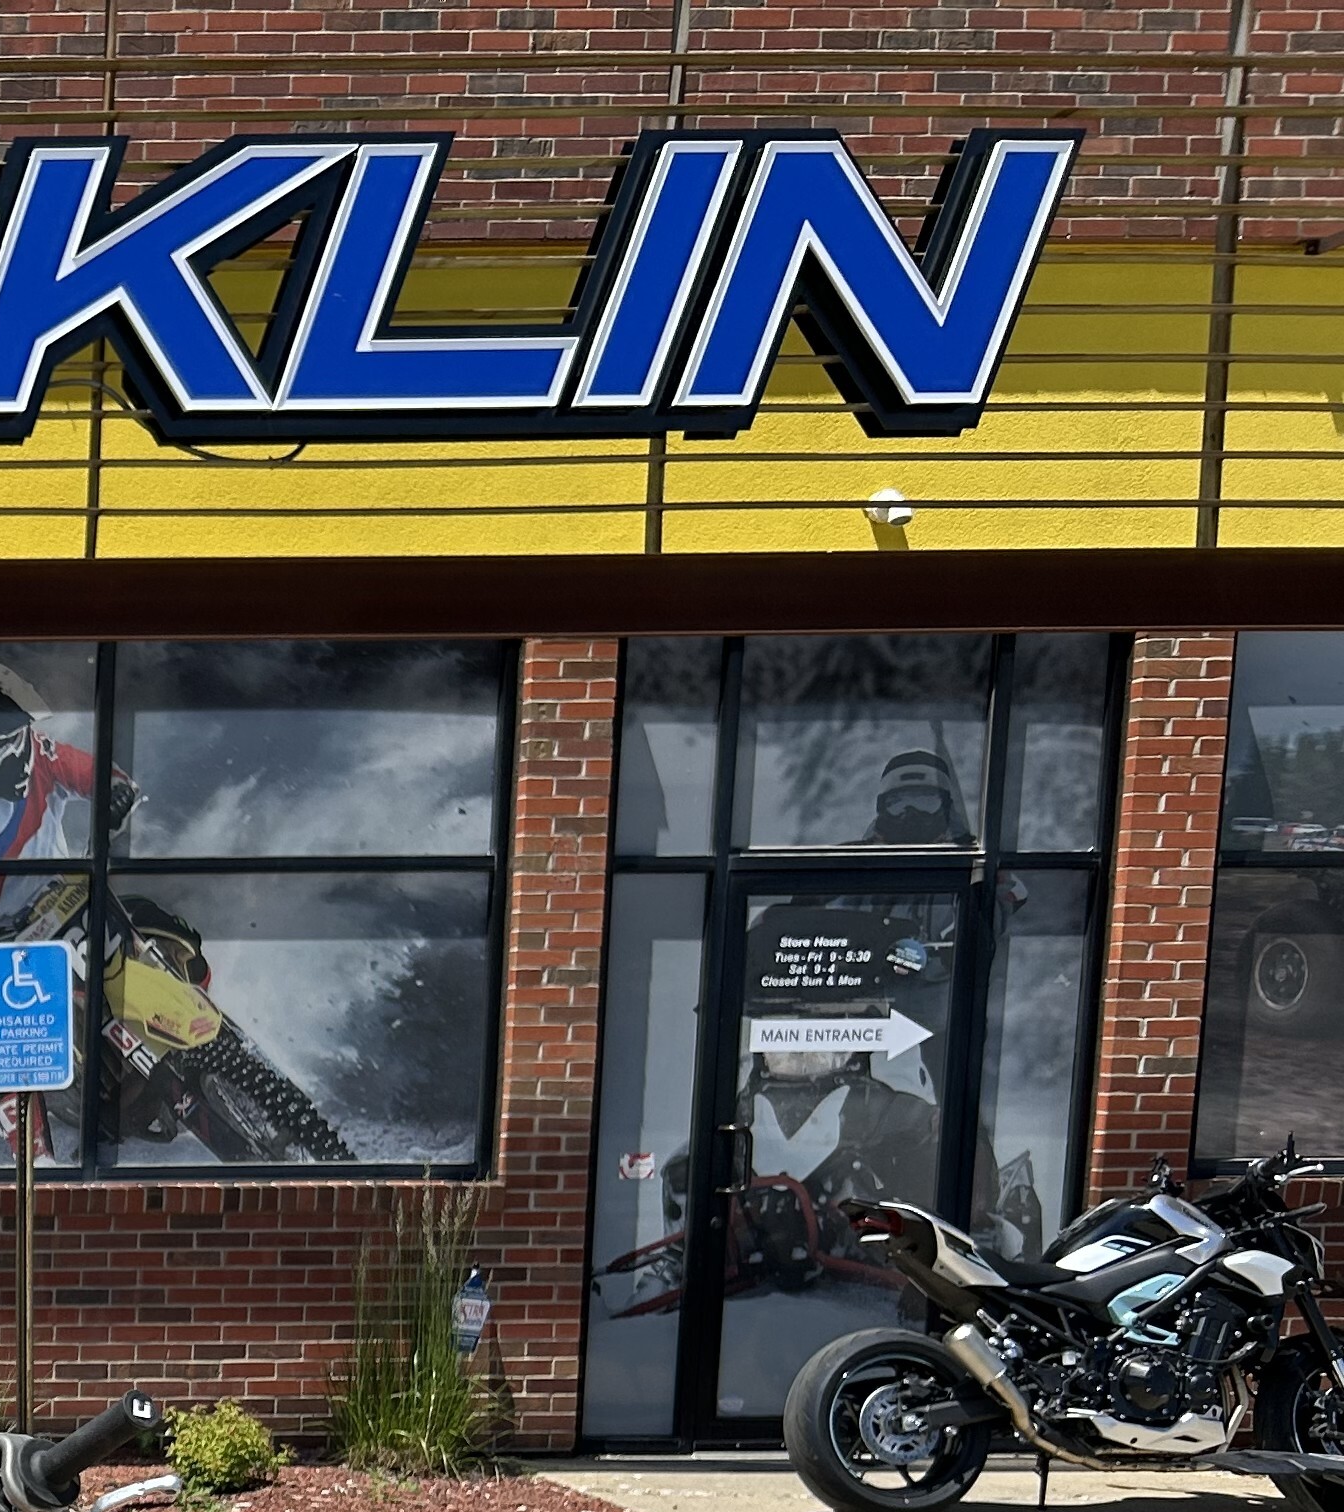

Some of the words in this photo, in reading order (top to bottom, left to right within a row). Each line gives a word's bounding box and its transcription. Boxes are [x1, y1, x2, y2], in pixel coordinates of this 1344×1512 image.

[779, 936, 811, 948] Store
[813, 936, 848, 948] Hours
[789, 963, 807, 974] Sat
[761, 975, 799, 987] Closed
[801, 975, 823, 987] Sun
[826, 975, 834, 986] &
[838, 975, 862, 986] Mon
[0, 1027, 48, 1039] PARKING
[761, 1028, 800, 1042] MAIN
[805, 1027, 883, 1042] ENTRANCE
[23, 1042, 64, 1055] PERMIT
